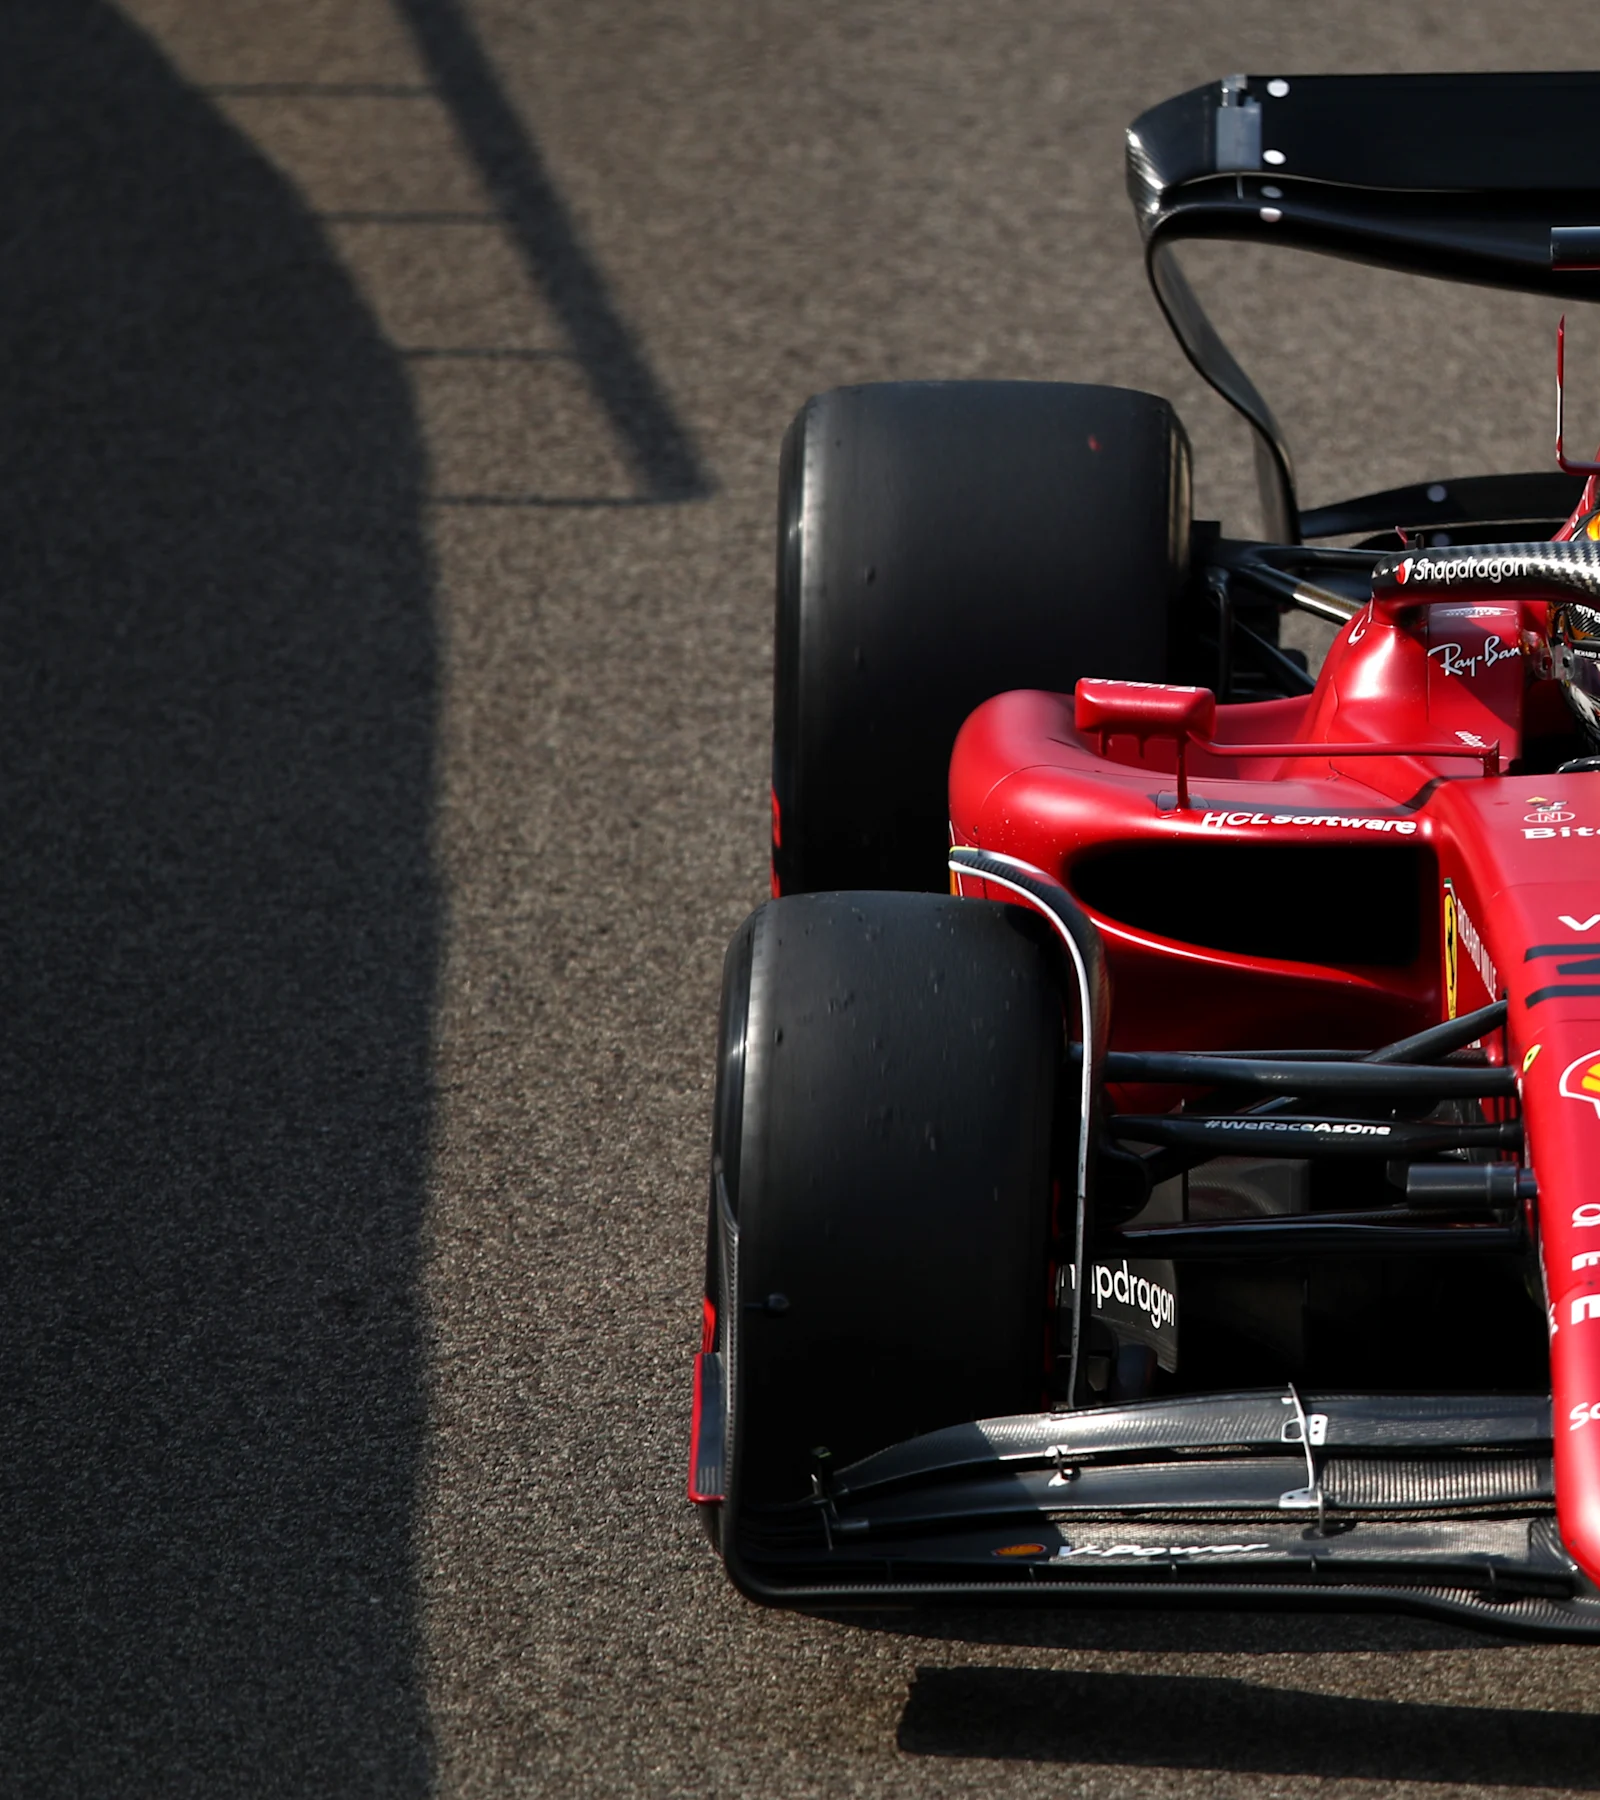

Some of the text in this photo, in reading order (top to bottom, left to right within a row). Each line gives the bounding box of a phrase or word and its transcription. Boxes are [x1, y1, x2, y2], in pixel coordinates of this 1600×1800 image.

[1413, 556, 1528, 585] Snapdragon
[1427, 635, 1522, 677] Ray-Ban
[1204, 1120, 1391, 1136] #WeRaceAsOne
[1059, 1543, 1270, 1557] V-Power
